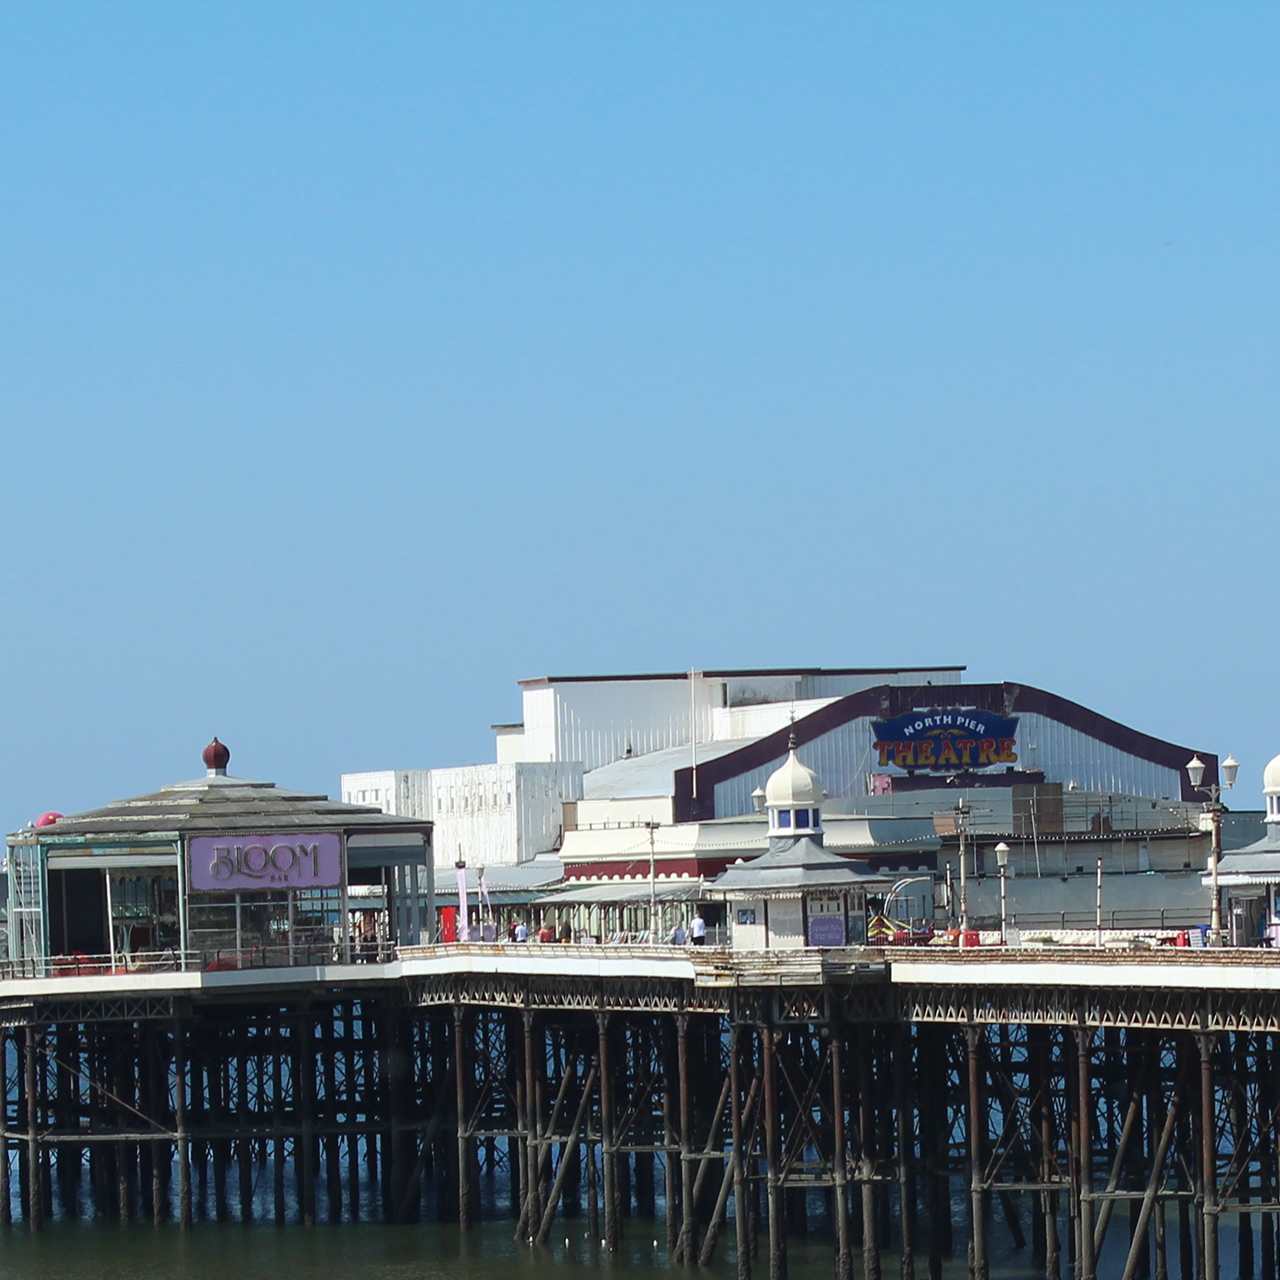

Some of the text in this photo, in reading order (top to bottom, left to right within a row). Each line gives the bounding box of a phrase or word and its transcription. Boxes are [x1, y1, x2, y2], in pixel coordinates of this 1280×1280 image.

[903, 715, 986, 736] NORTH PIER
[872, 737, 1018, 767] THEATRE
[209, 843, 319, 881] BLOOM
[270, 874, 290, 882] BAR
